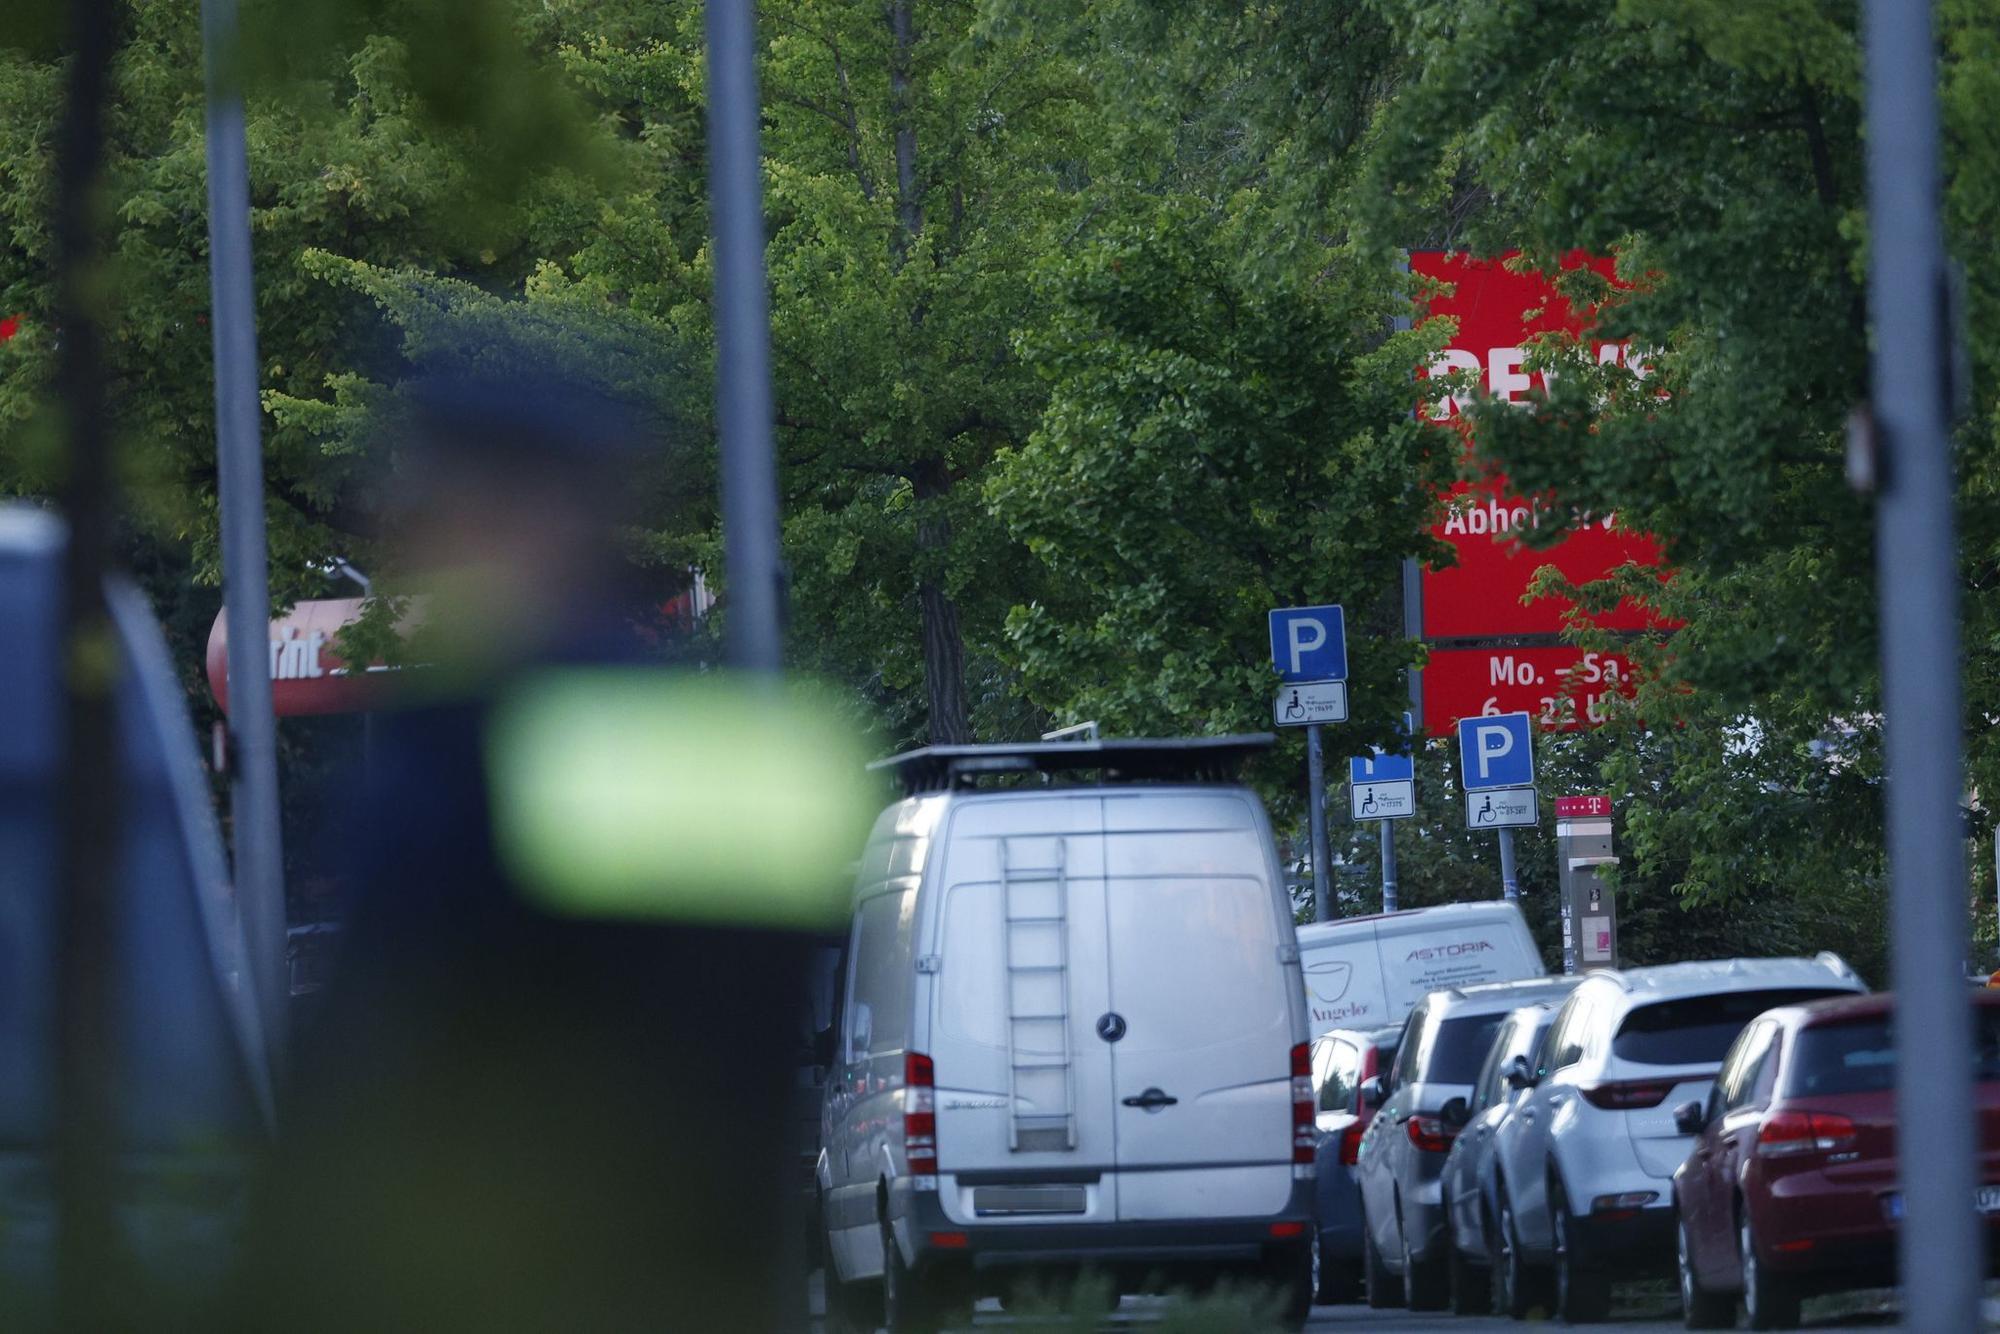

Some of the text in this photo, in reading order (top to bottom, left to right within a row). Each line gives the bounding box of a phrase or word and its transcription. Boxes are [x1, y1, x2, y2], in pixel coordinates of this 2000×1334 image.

[1288, 617, 1326, 673] P
[1489, 655, 1545, 686] Mo.
[1583, 652, 1629, 683] Sa.
[1477, 725, 1513, 778] P
[1406, 941, 1495, 961] ASTORIA
